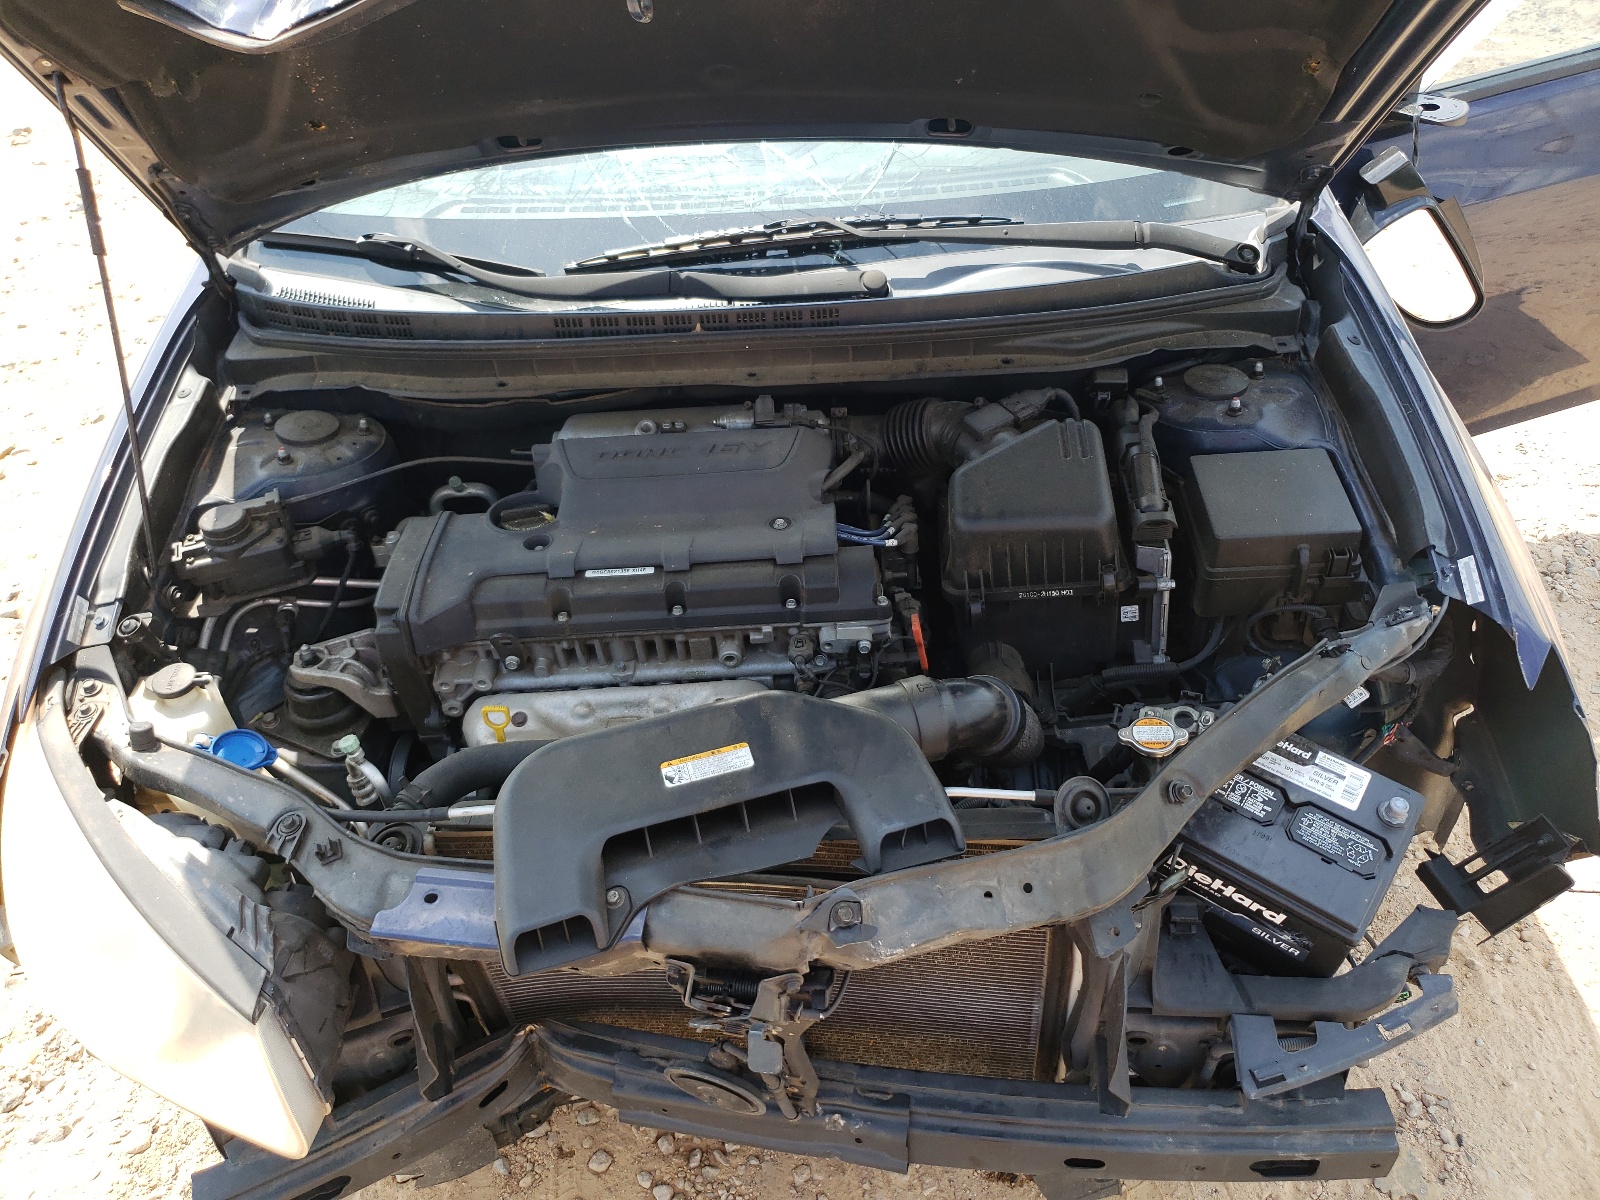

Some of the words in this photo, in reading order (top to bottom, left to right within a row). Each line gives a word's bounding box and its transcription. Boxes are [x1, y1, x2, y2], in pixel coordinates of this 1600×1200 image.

[1276, 740, 1312, 760] eHard
[1312, 770, 1339, 786] SILVER
[1248, 780, 1275, 797] POISON
[1166, 854, 1288, 926] DieHard
[1251, 927, 1301, 957] SILVER
